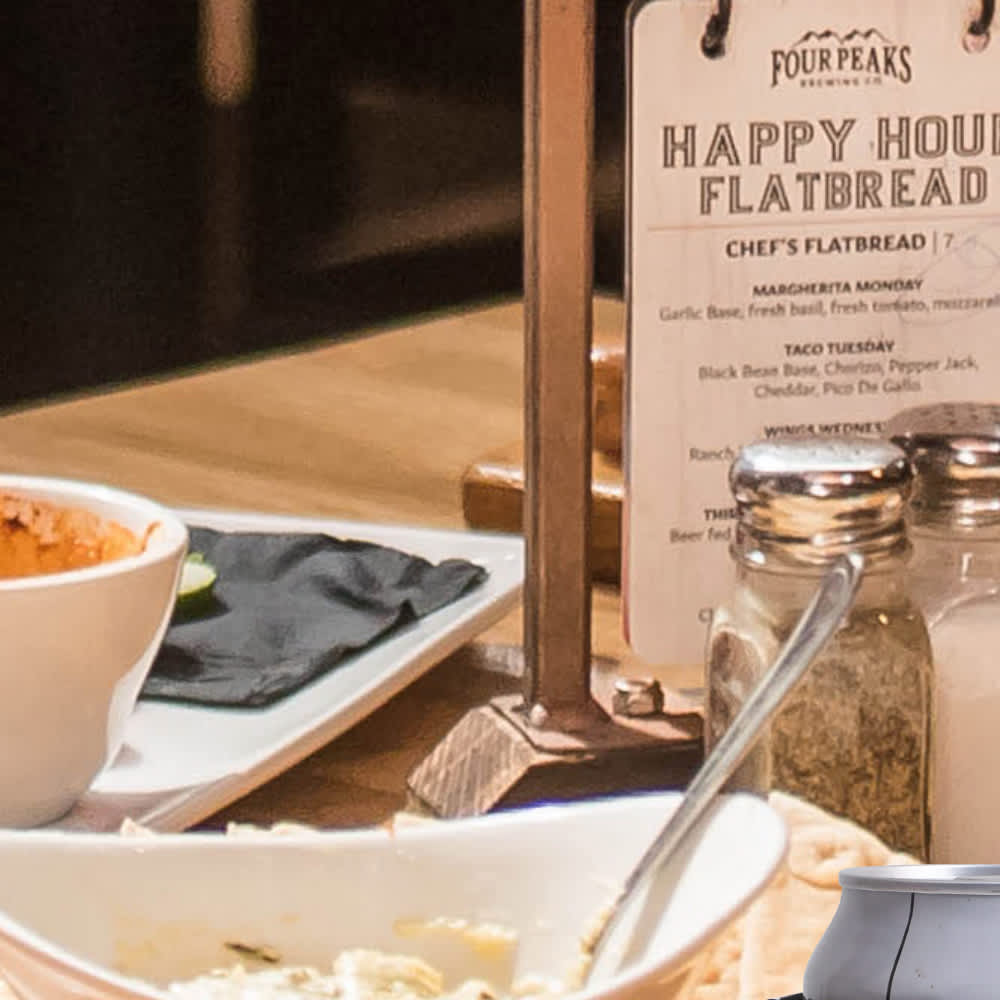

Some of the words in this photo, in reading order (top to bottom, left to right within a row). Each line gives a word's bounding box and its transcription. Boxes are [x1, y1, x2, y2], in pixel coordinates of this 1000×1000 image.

[771, 47, 832, 88] FOUR
[836, 45, 912, 85] PEAKS
[662, 118, 856, 169] HAPPY
[699, 166, 988, 216] FLATBREAD
[725, 238, 798, 259] CHEF'S
[804, 234, 926, 255] FLATBREAD
[943, 233, 955, 249] 7
[752, 281, 851, 297] MARGHERITA
[855, 278, 924, 294] MONDAY
[659, 305, 701, 321] Garlic
[706, 304, 745, 319] Base,
[748, 303, 786, 317] fresh
[789, 300, 828, 317] basil,
[830, 299, 868, 314] fresh
[784, 343, 824, 357] TACO
[827, 340, 895, 355] TUESDAY
[698, 364, 738, 380] Black
[741, 363, 778, 378] Bean
[783, 362, 819, 378] Base,
[824, 359, 885, 377] Chorizo,
[889, 358, 941, 375] Pepper
[944, 355, 980, 371] Jack,
[753, 382, 820, 399] Cheddar,
[823, 381, 854, 395] Pico
[857, 379, 879, 394] De
[818, 421, 885, 434] WEDNES
[689, 446, 735, 461] Ranch
[669, 528, 704, 544] Beer
